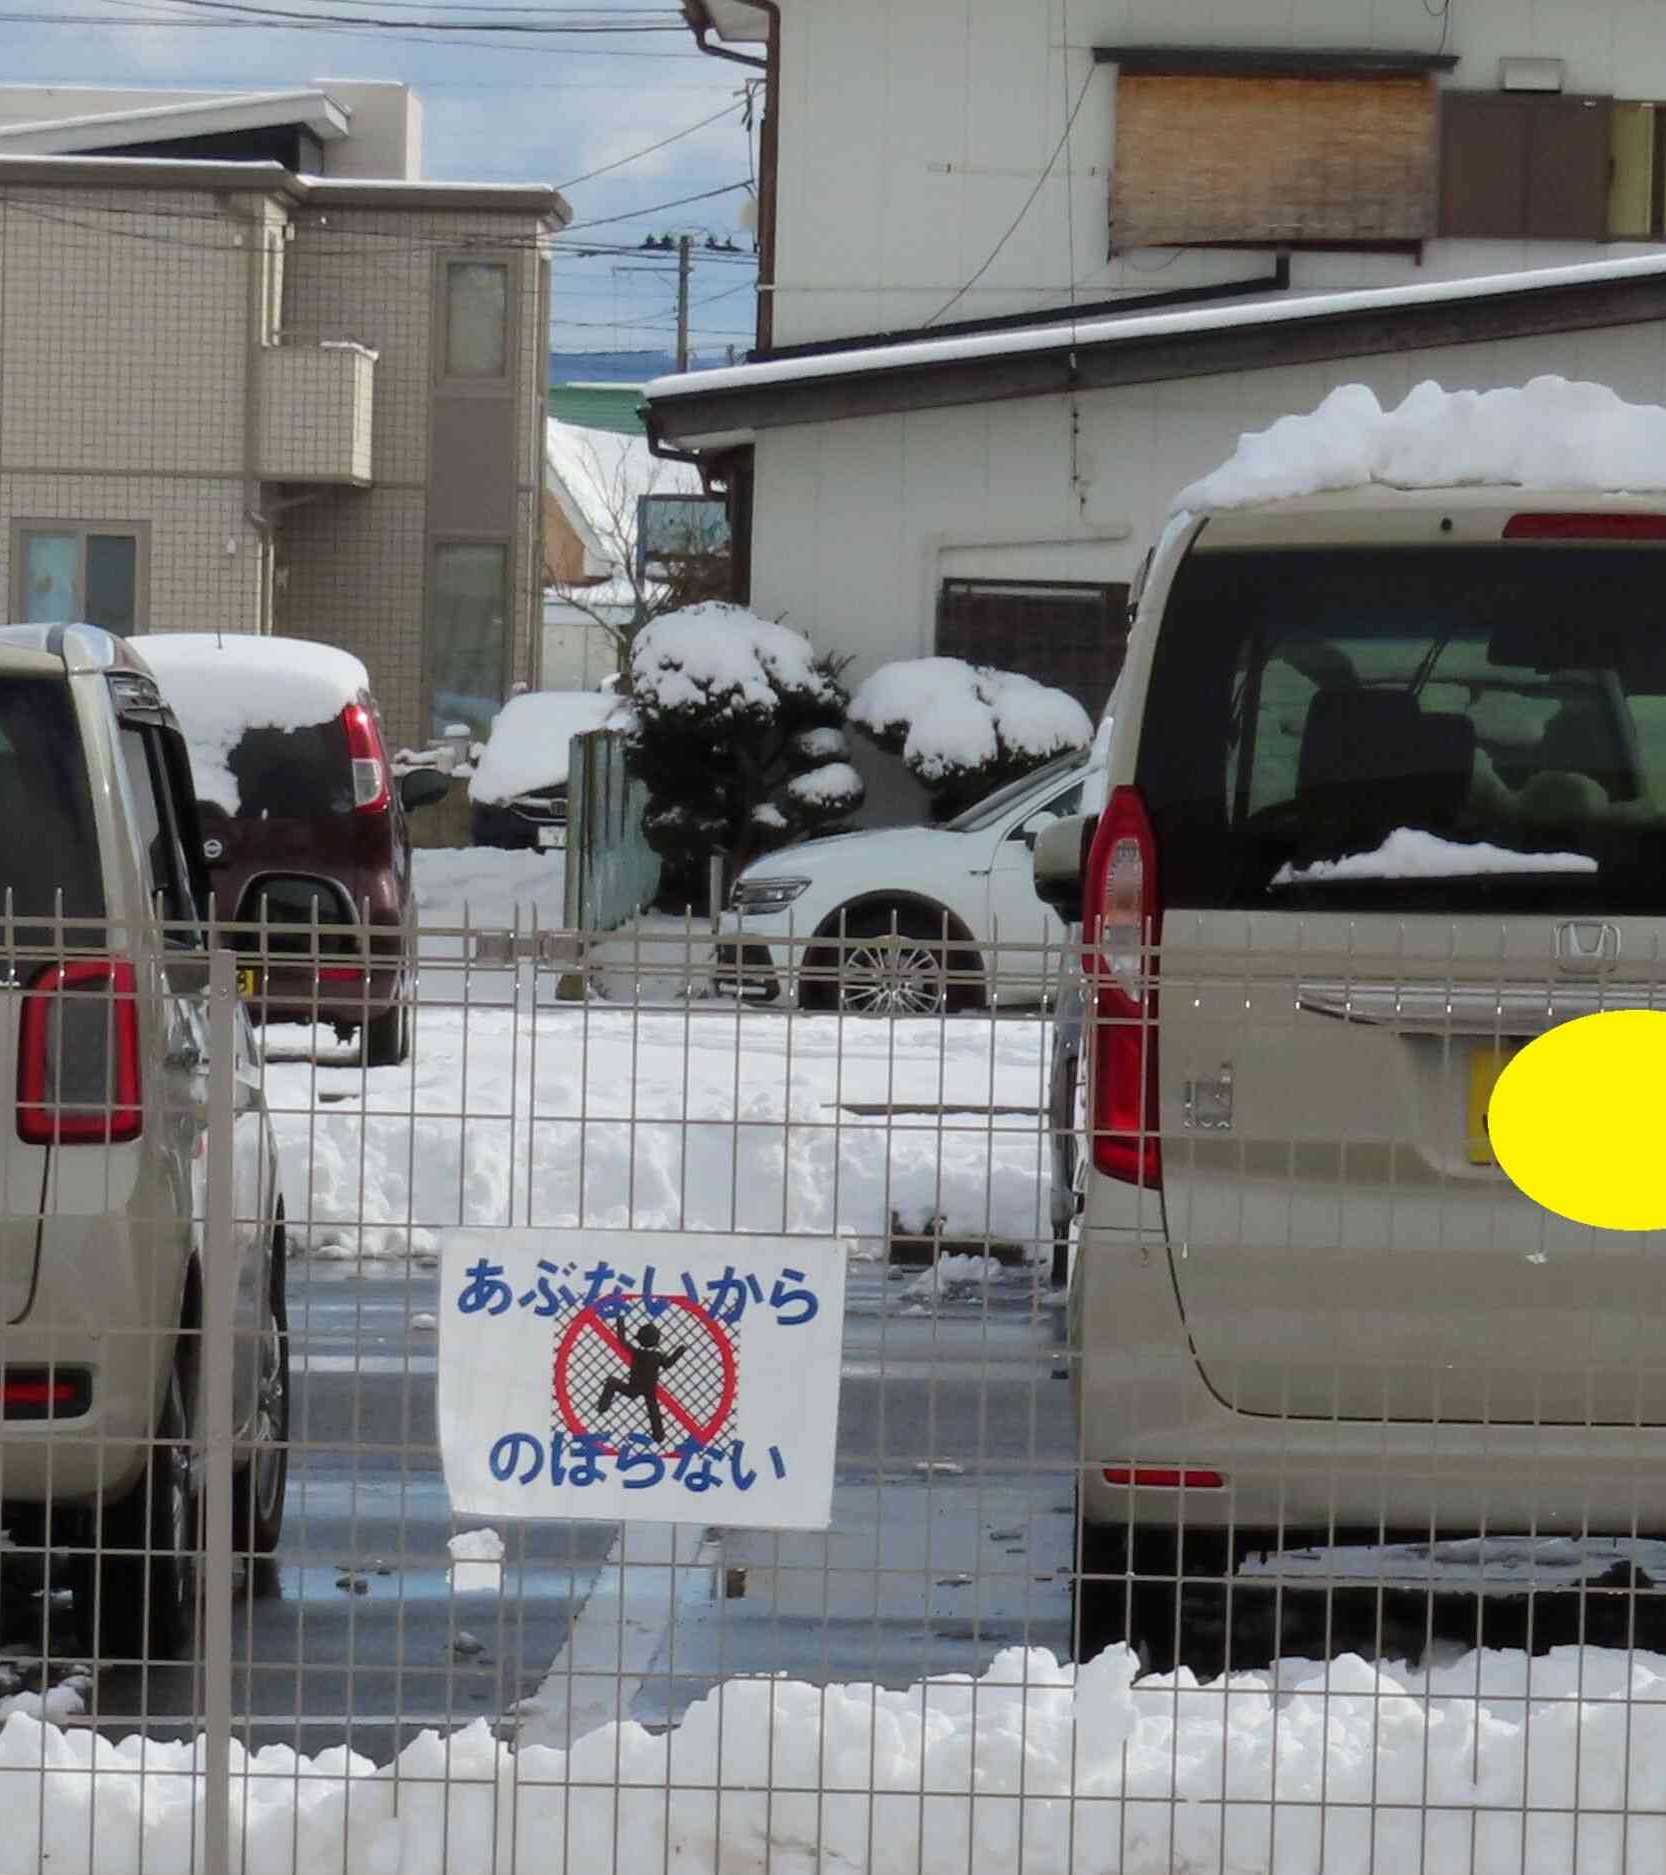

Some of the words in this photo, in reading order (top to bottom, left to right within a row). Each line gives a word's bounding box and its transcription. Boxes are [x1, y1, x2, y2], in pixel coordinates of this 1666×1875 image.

[457, 1258, 819, 1326] あぶないから
